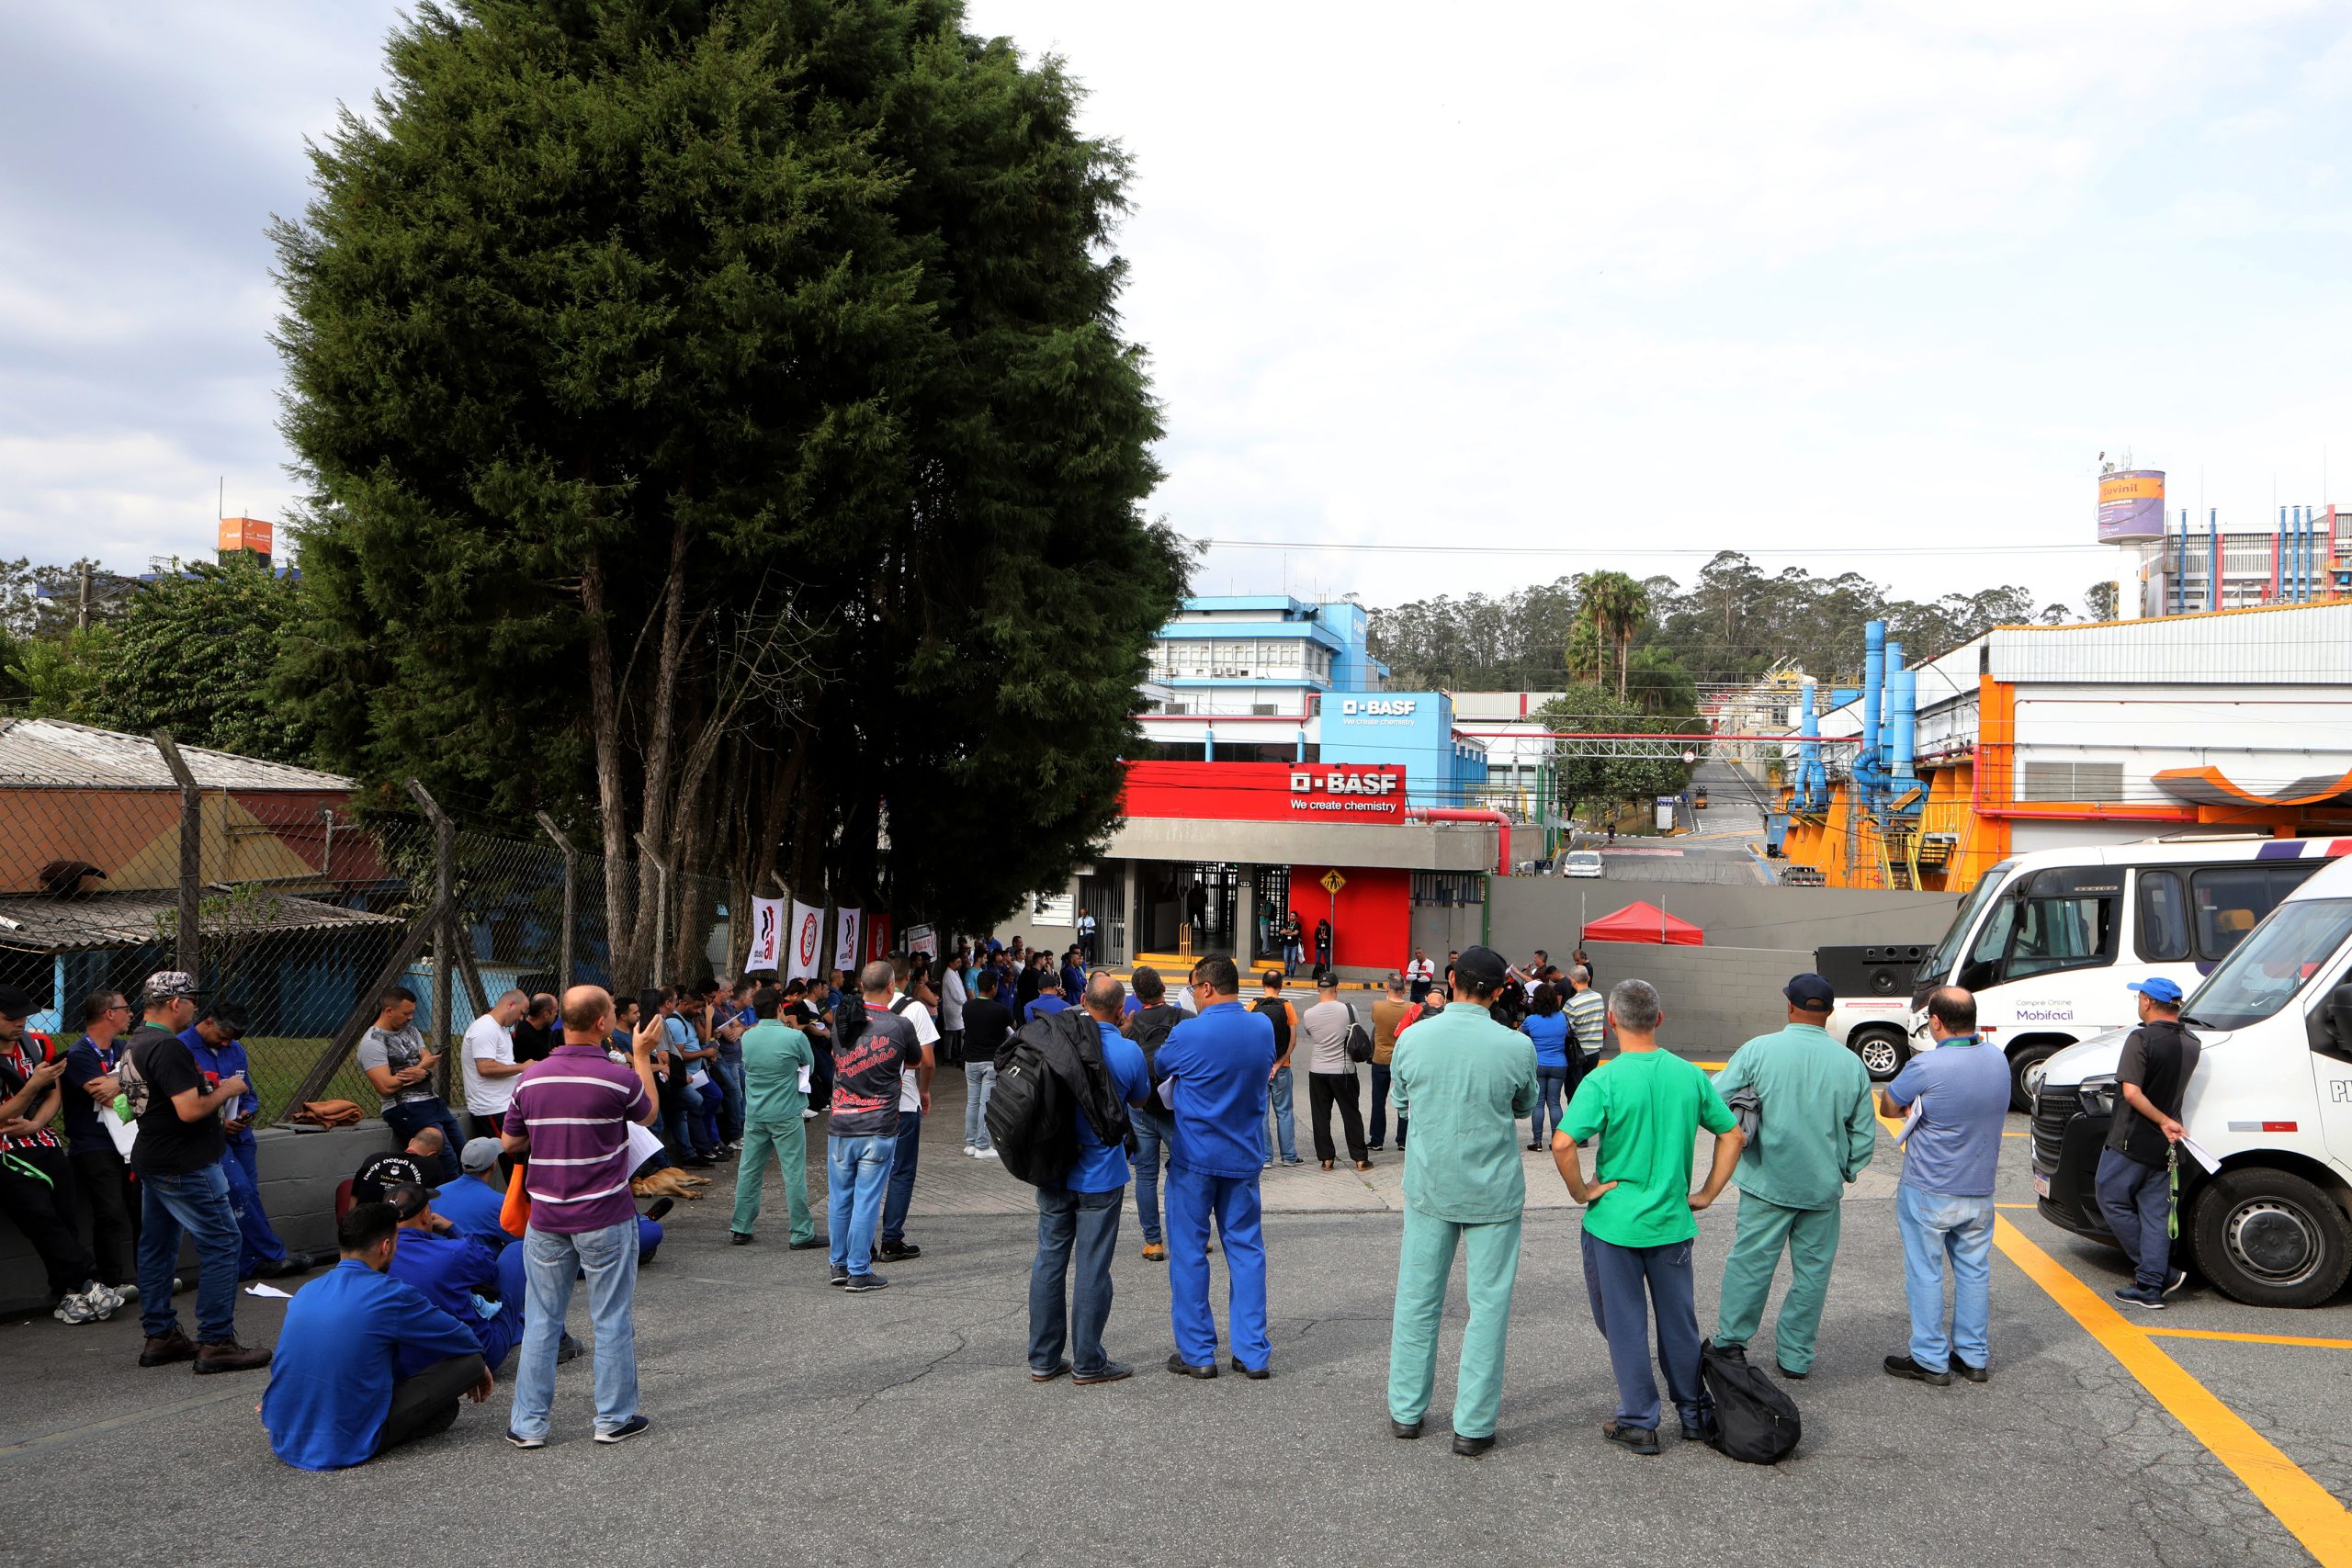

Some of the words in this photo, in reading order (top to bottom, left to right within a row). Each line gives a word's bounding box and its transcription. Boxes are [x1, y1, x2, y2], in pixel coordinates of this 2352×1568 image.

[2103, 483, 2138, 496] Suvinil
[1367, 700, 1416, 716] BASF
[1381, 717, 1416, 727] chemistry
[1328, 773, 1397, 795] BASF
[1291, 800, 1307, 809] We
[1309, 801, 1342, 810] create
[1344, 800, 1396, 813] chemistry
[383, 1157, 409, 1167] ocean
[409, 1163, 422, 1185] water
